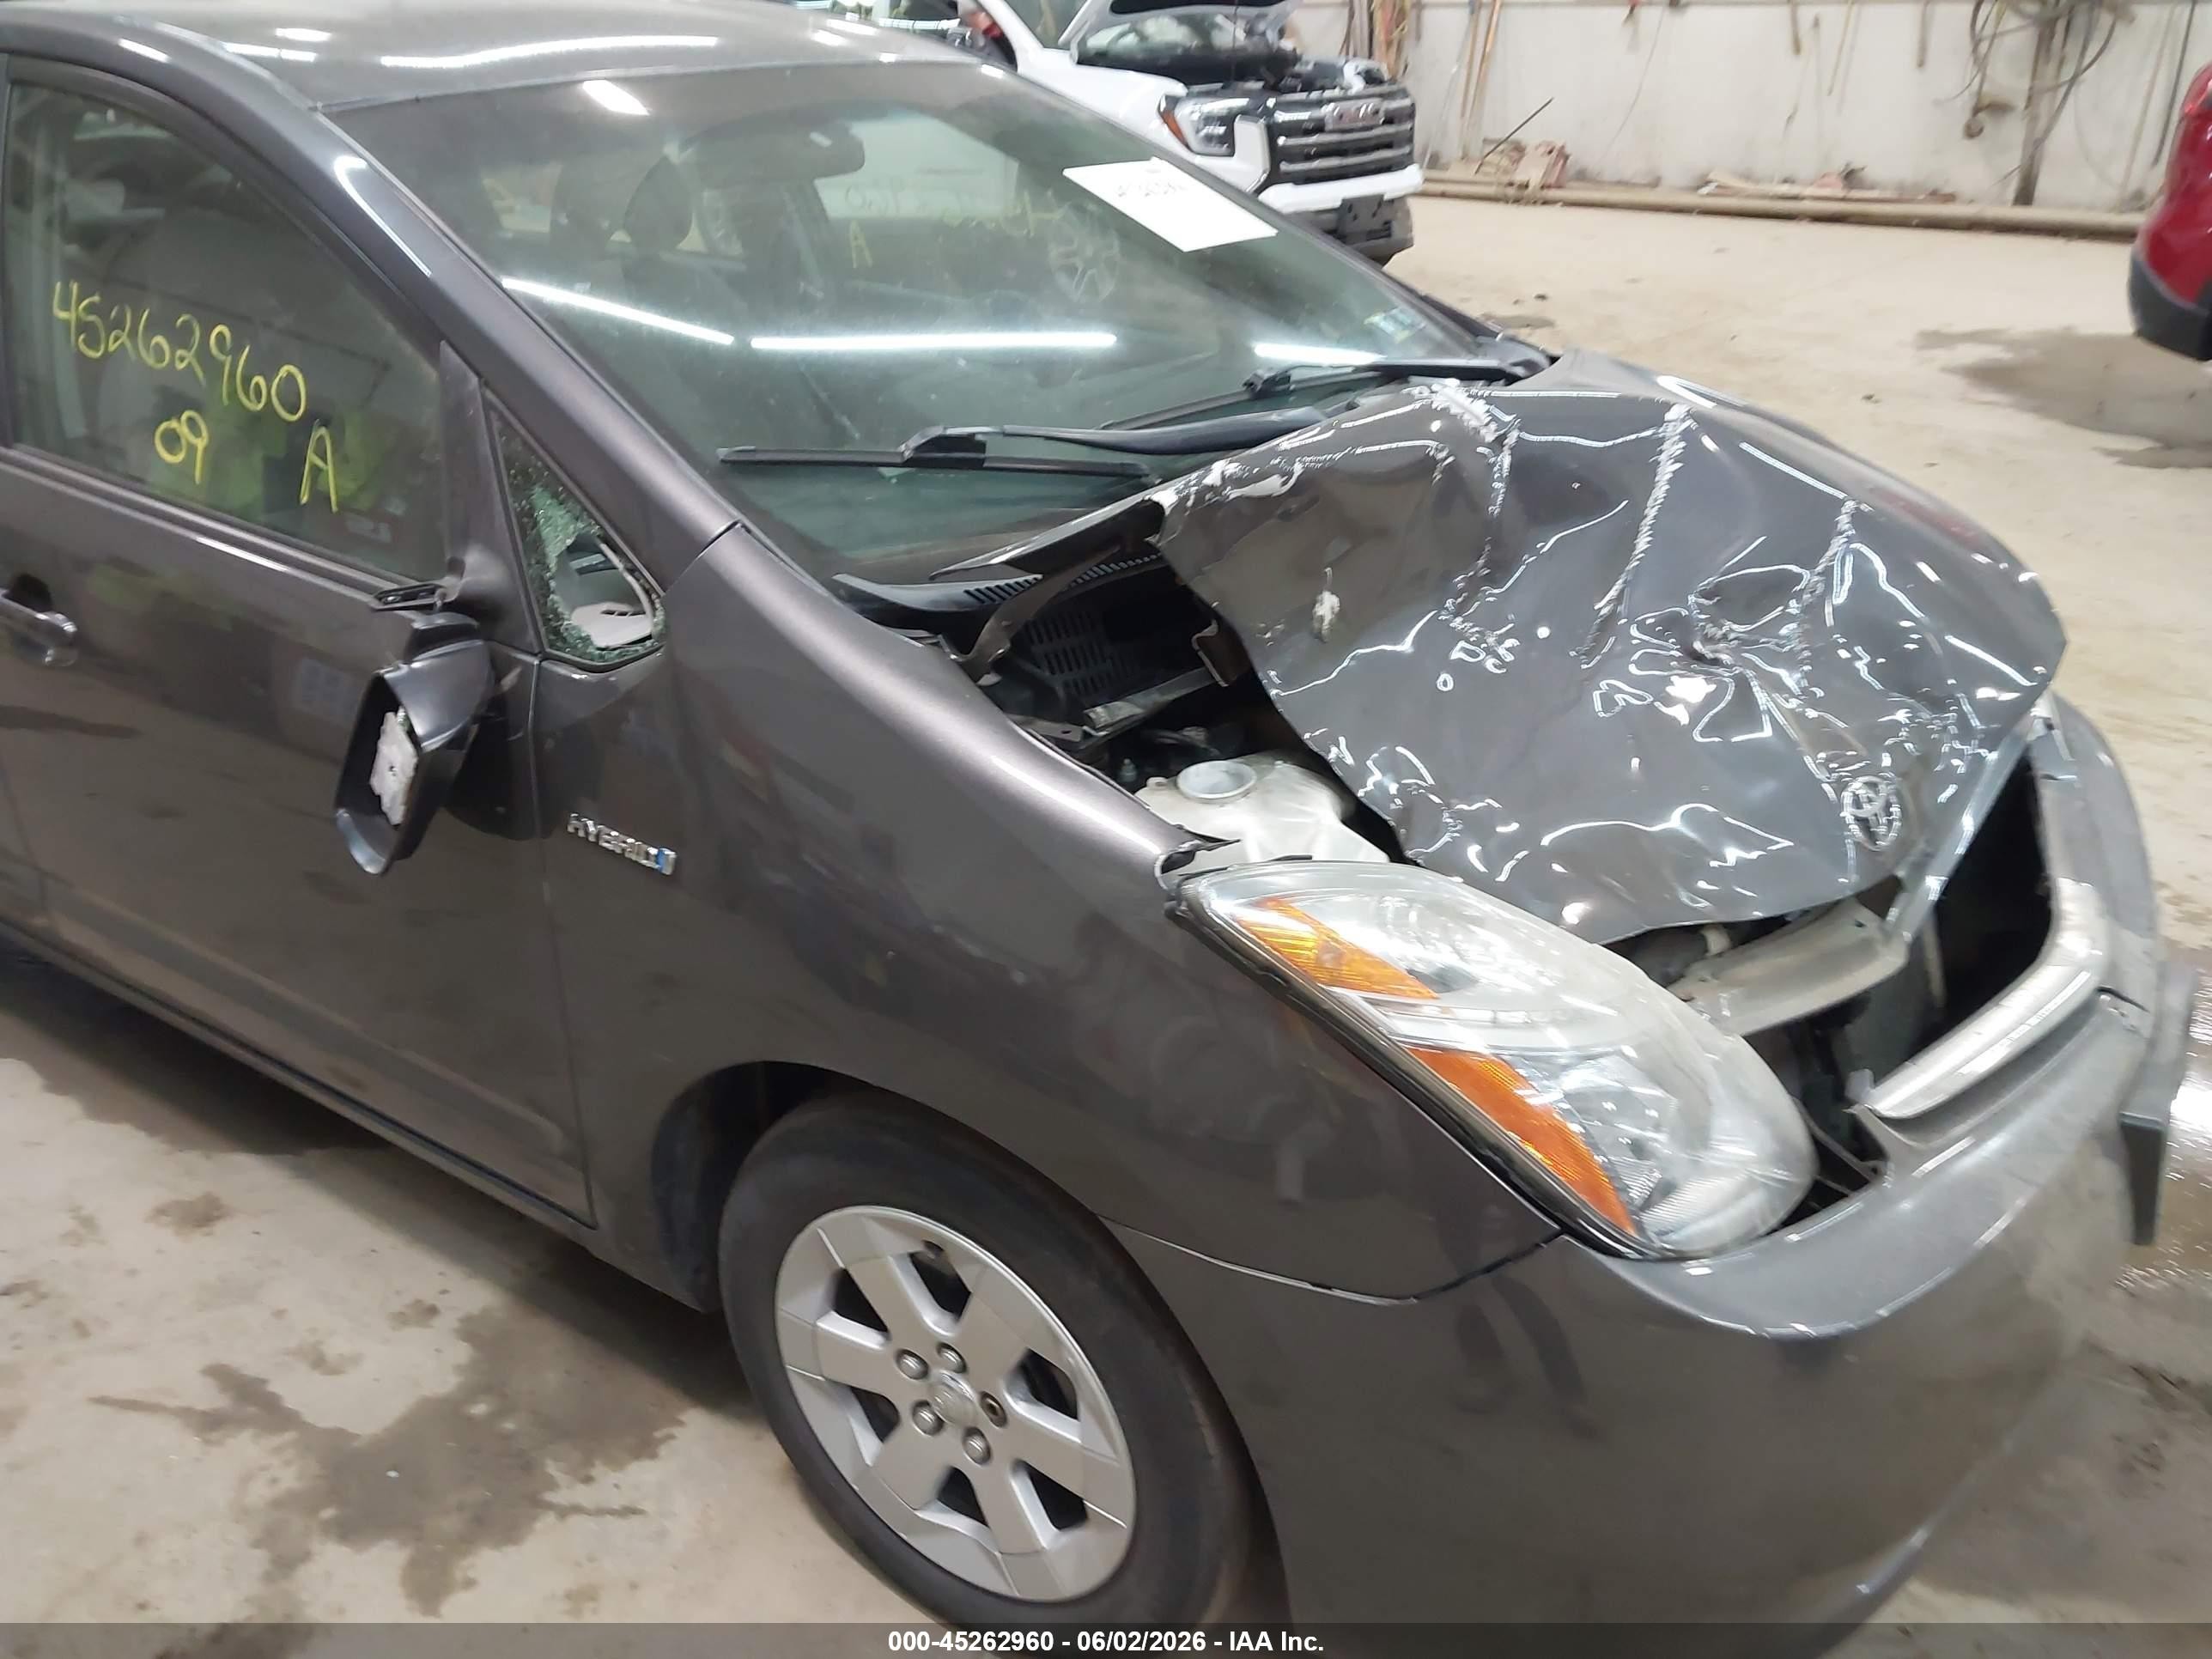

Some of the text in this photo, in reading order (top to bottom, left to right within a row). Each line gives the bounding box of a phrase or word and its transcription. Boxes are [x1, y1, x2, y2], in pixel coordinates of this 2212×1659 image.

[52, 280, 307, 422] 45262960
[155, 410, 210, 484] 09
[299, 419, 339, 514] A
